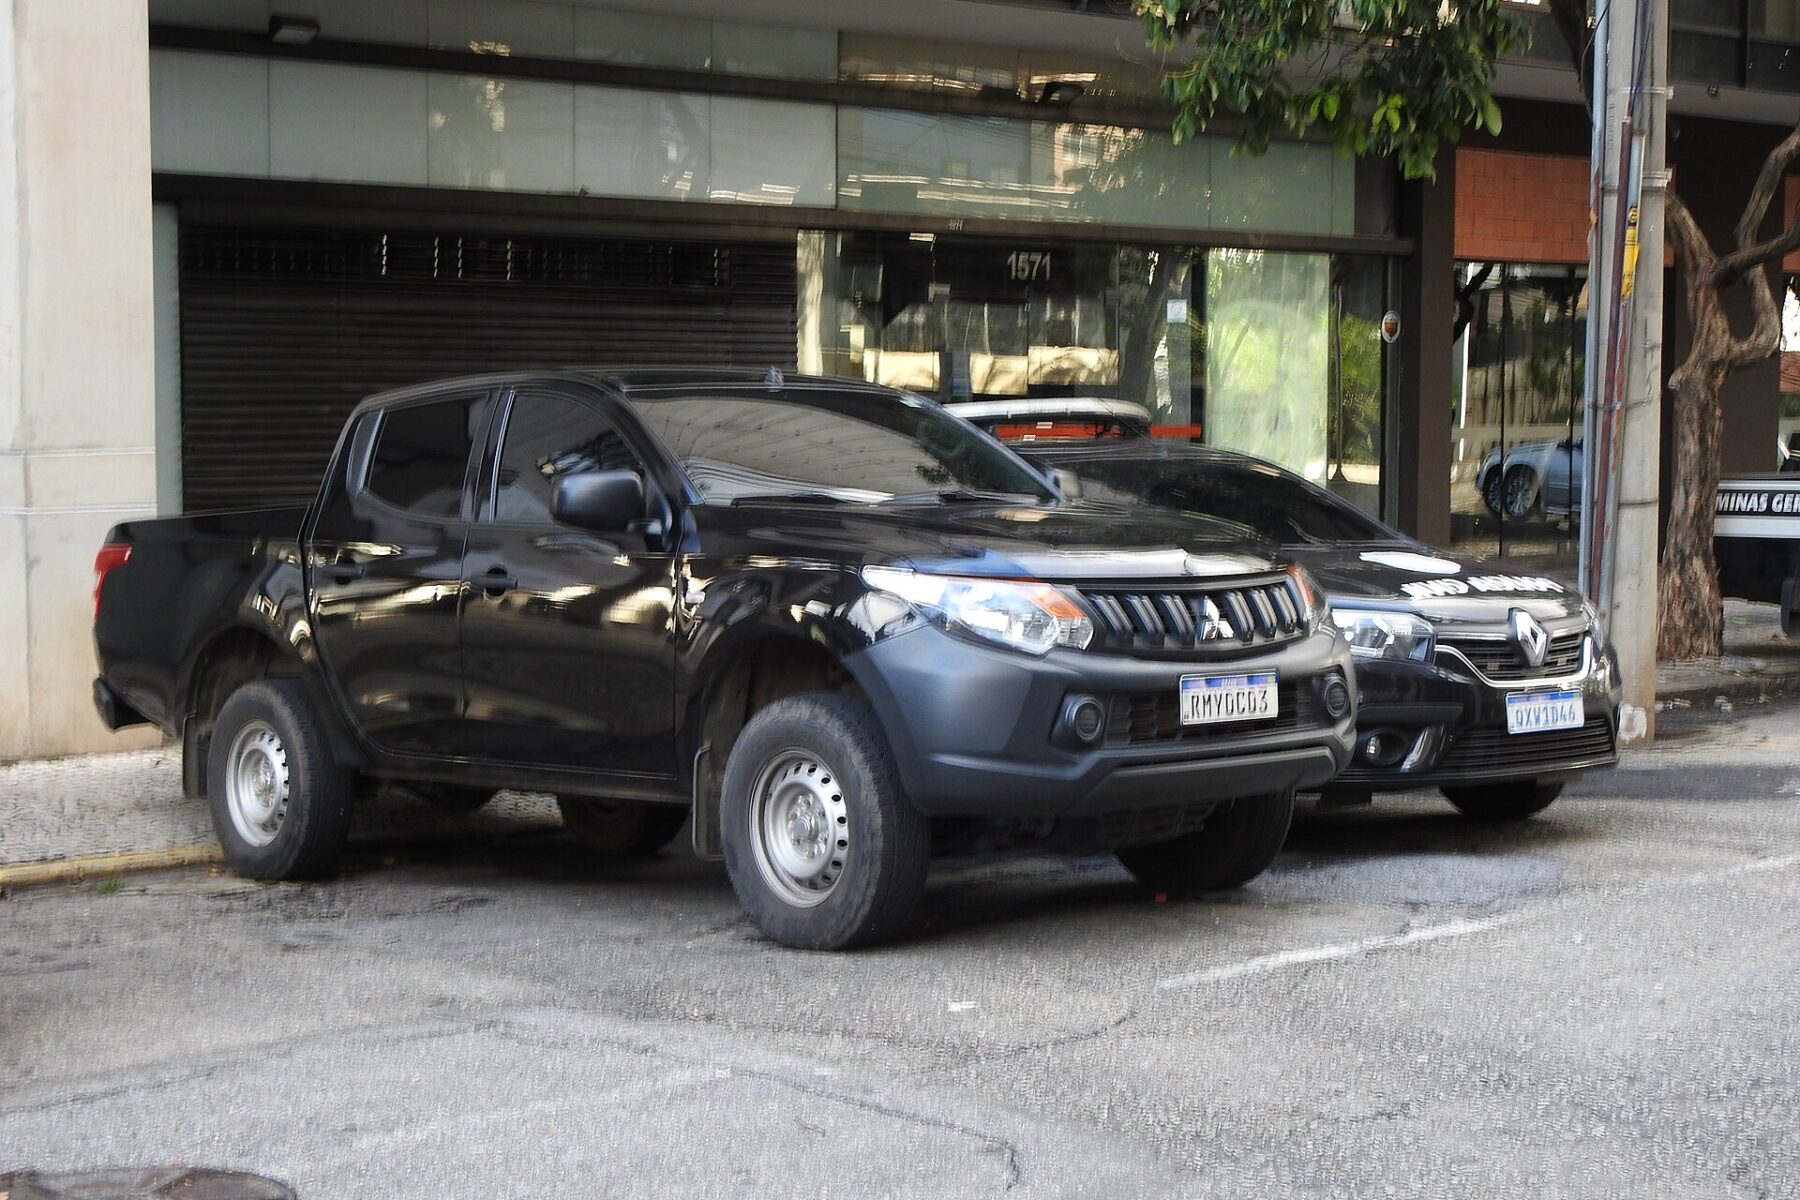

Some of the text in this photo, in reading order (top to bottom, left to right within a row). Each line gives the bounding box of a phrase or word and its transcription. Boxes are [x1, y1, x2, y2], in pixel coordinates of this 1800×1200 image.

[1007, 251, 1051, 280] 1571
[1715, 492, 1769, 512] MINAS
[1191, 689, 1268, 719] RMY0C03
